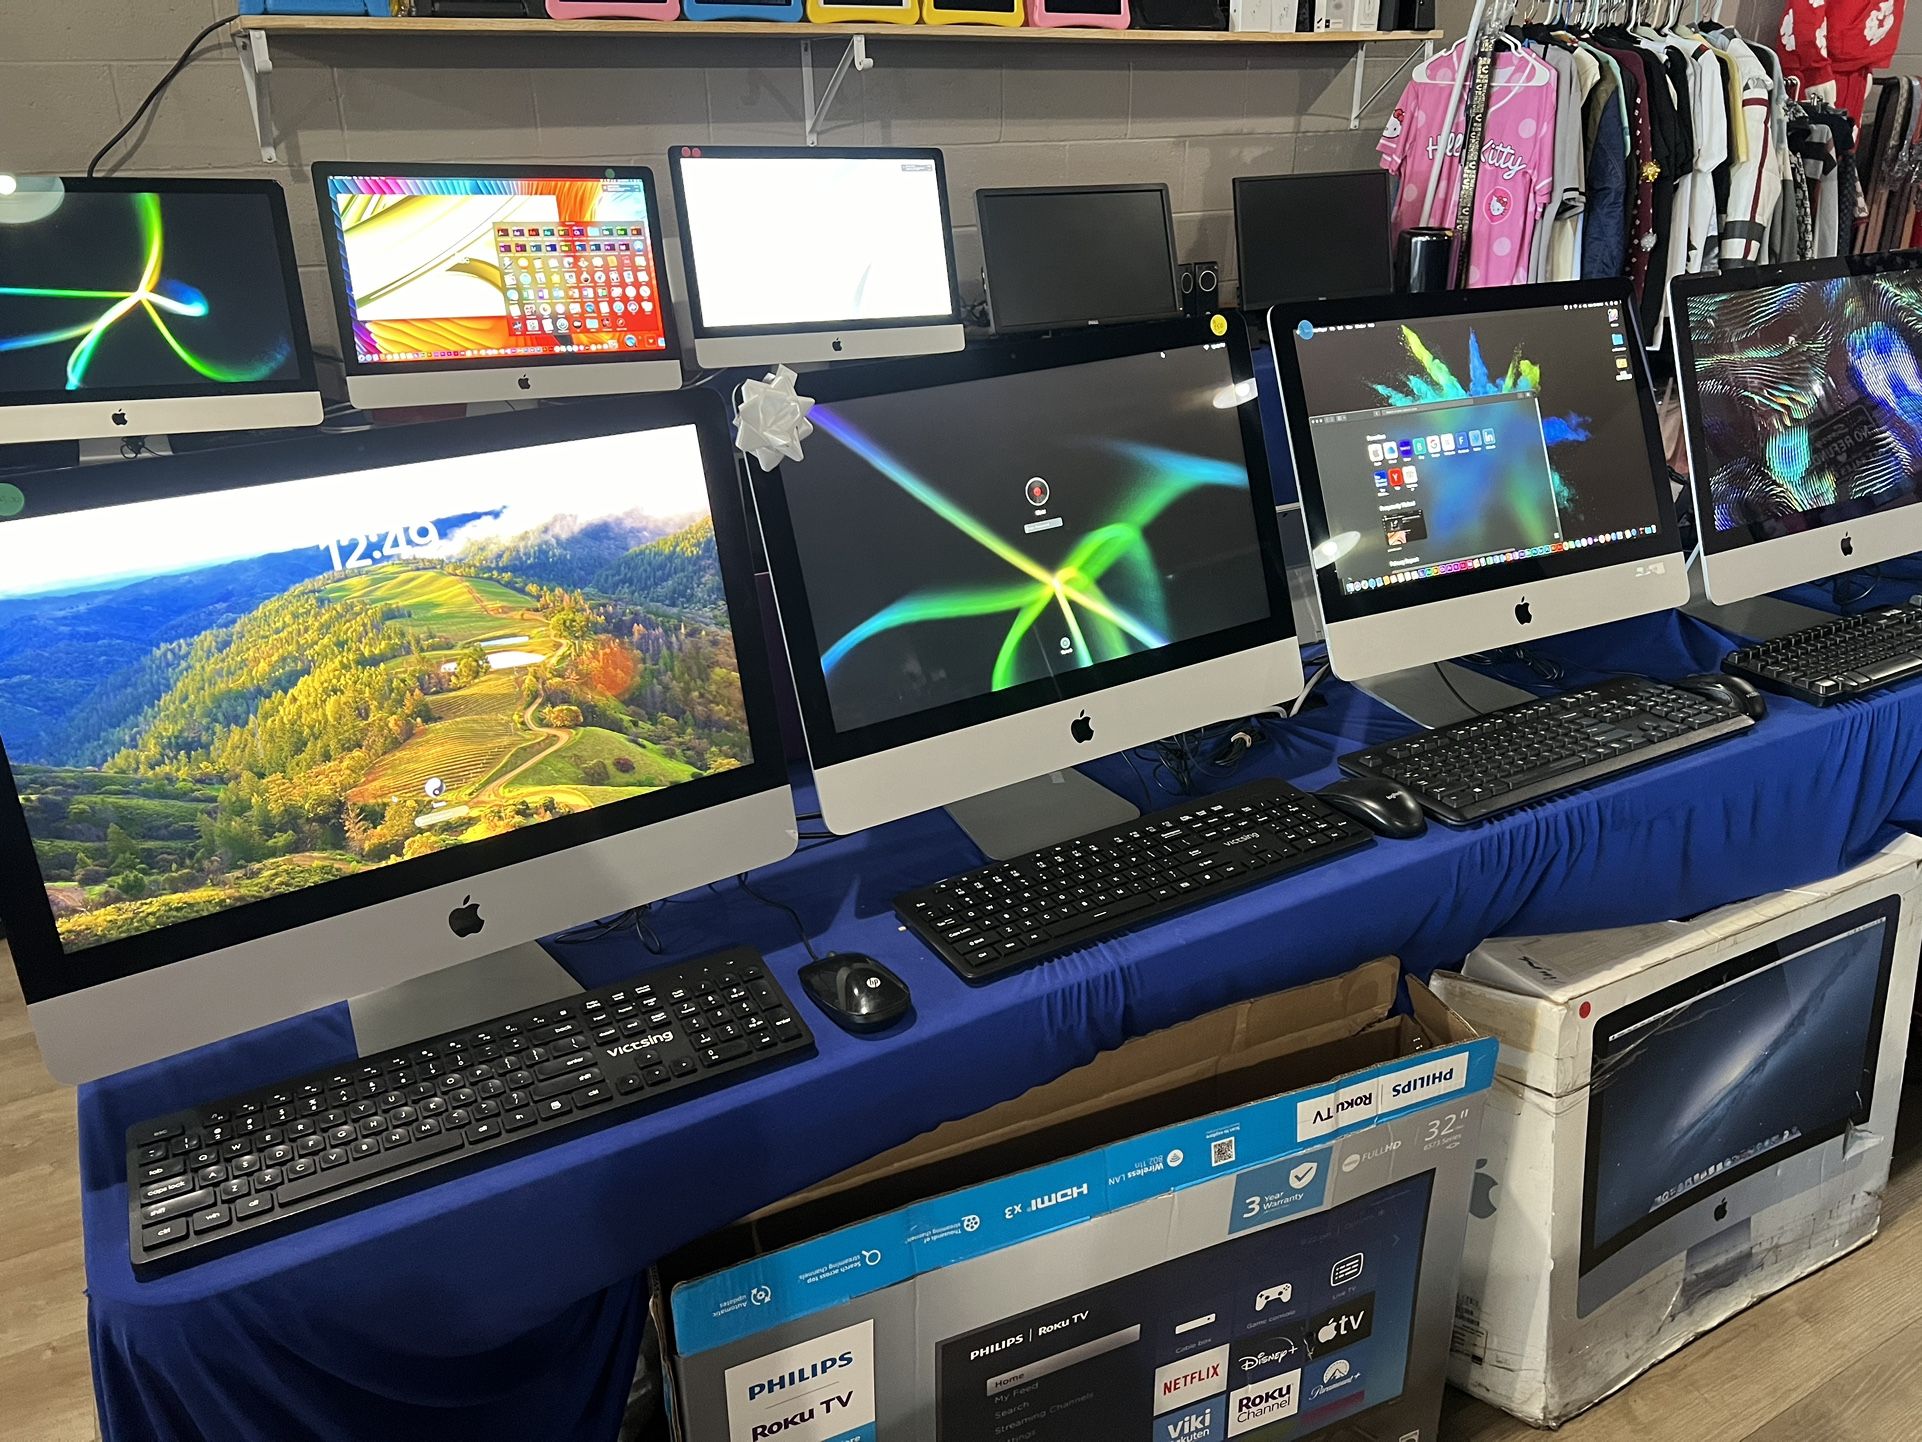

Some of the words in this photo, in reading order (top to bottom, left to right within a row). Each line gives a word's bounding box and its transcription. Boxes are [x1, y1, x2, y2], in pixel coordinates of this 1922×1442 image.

[1426, 132, 1467, 159] Hll
[1480, 139, 1527, 180] Kitty
[318, 521, 440, 572] 12:49
[1391, 1067, 1454, 1098] PHILIPS
[1336, 1092, 1372, 1114] Roku
[1312, 1107, 1334, 1124] TV
[1109, 1174, 1126, 1185] LAN
[1128, 1163, 1164, 1179] Wireless
[147, 1186, 168, 1197] caps
[168, 1180, 186, 1190] lock
[1004, 1203, 1022, 1219] x3
[1242, 1196, 1261, 1218] 3
[1264, 1192, 1284, 1202] Year
[1263, 1193, 1304, 1210] Warranty
[150, 1207, 166, 1216] shift
[829, 1254, 860, 1269] streaming
[840, 1261, 861, 1272] Search
[820, 1268, 839, 1279] across
[712, 1301, 747, 1318] Automatic
[719, 1294, 747, 1308] updates
[1339, 1310, 1365, 1335] tv
[970, 1334, 1024, 1360] PHILIPS
[1038, 1319, 1070, 1336] Roku
[1072, 1310, 1089, 1323] TV
[748, 1351, 853, 1401] PHILIPS
[995, 1372, 1024, 1388] Home
[1163, 1363, 1220, 1396] NETFLIX
[995, 1393, 1010, 1404] My
[1013, 1382, 1039, 1397] Feed
[1238, 1384, 1291, 1413] Roku
[752, 1408, 814, 1442] Roku
[820, 1390, 853, 1414] TV
[995, 1402, 1030, 1419] Search
[995, 1410, 1046, 1435] Streaming
[1050, 1392, 1094, 1413] Channels
[1237, 1396, 1291, 1423] Channel
